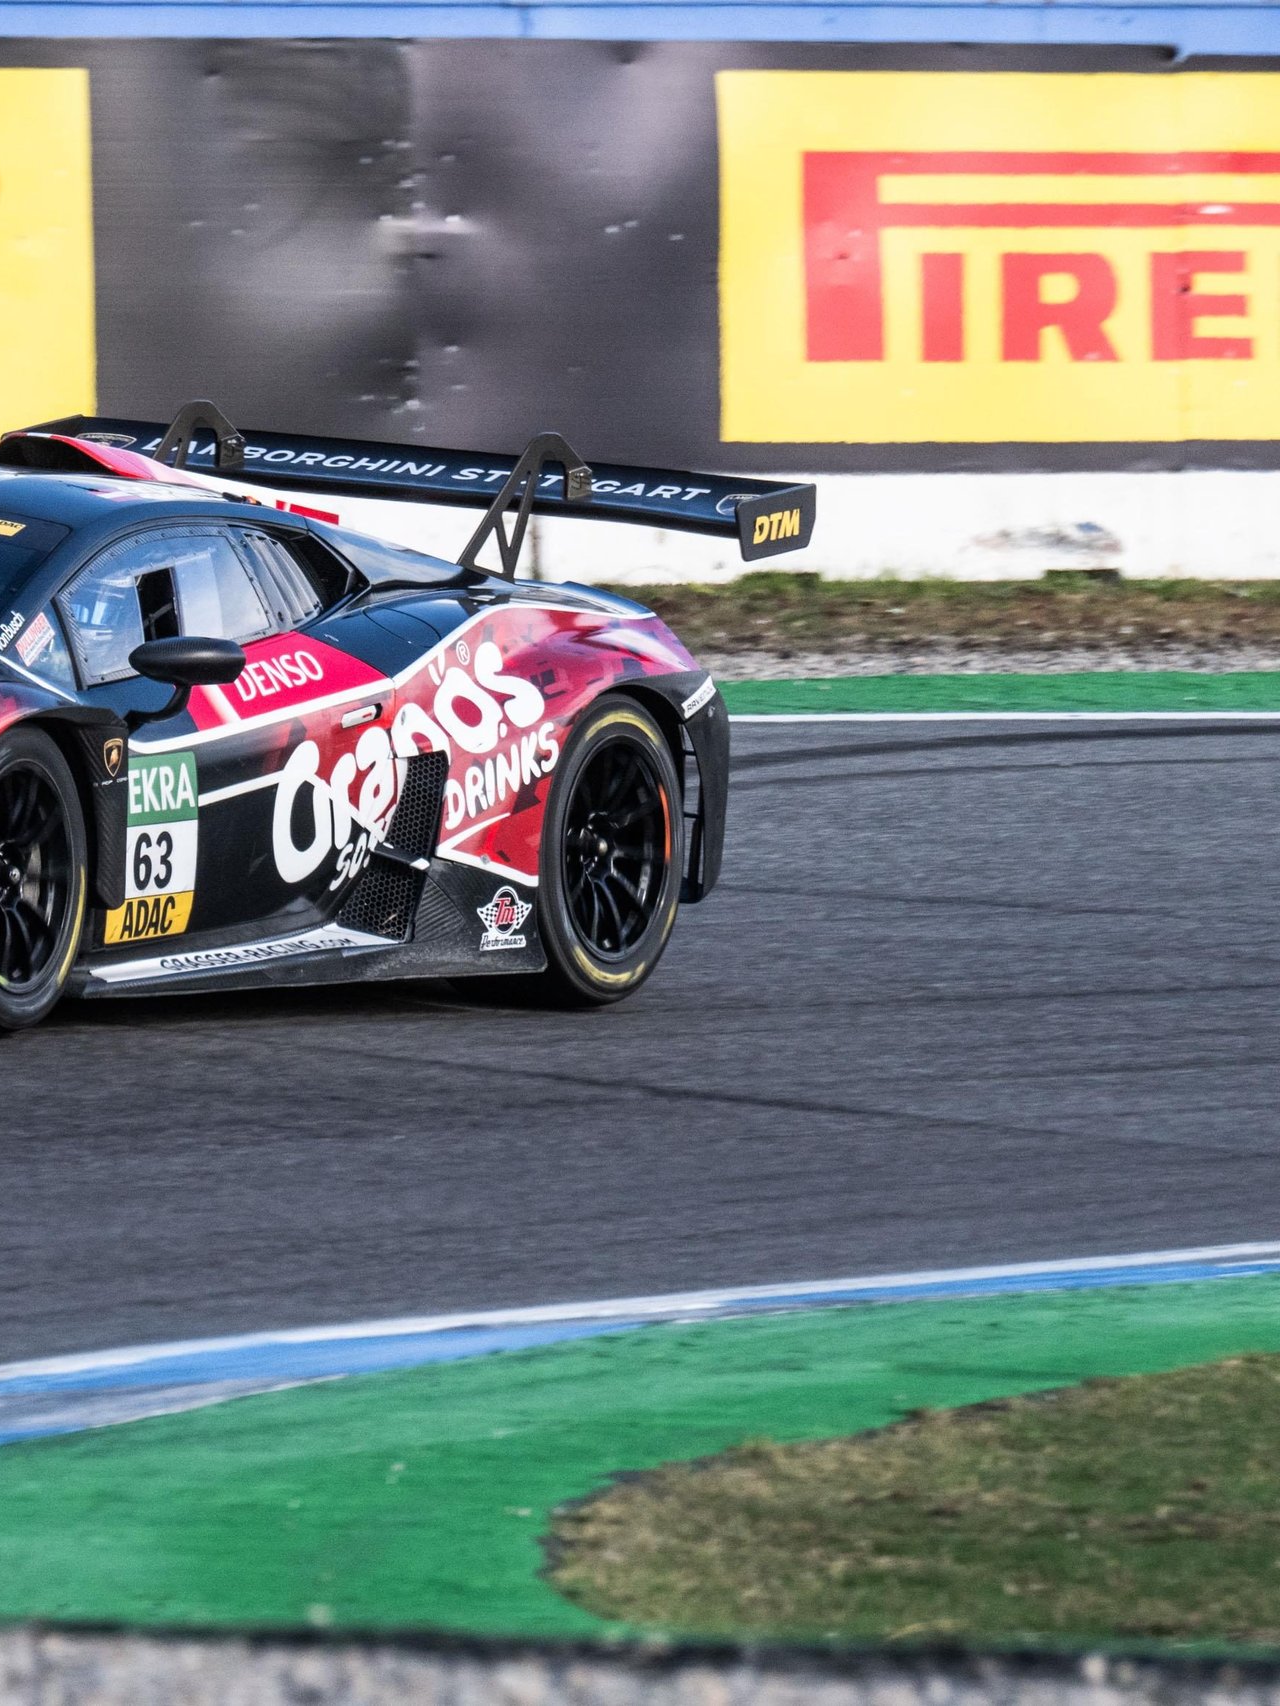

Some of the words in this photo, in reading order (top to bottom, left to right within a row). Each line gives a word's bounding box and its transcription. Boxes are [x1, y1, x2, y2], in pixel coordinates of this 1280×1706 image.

[802, 150, 1280, 363] PIRE
[451, 467, 711, 501] STTGART
[753, 508, 800, 545] DTM
[234, 650, 324, 702] DENSO
[128, 762, 195, 815] EKRA
[443, 721, 559, 830] DRINKS
[133, 831, 174, 891] 63
[120, 895, 176, 940] ADAC
